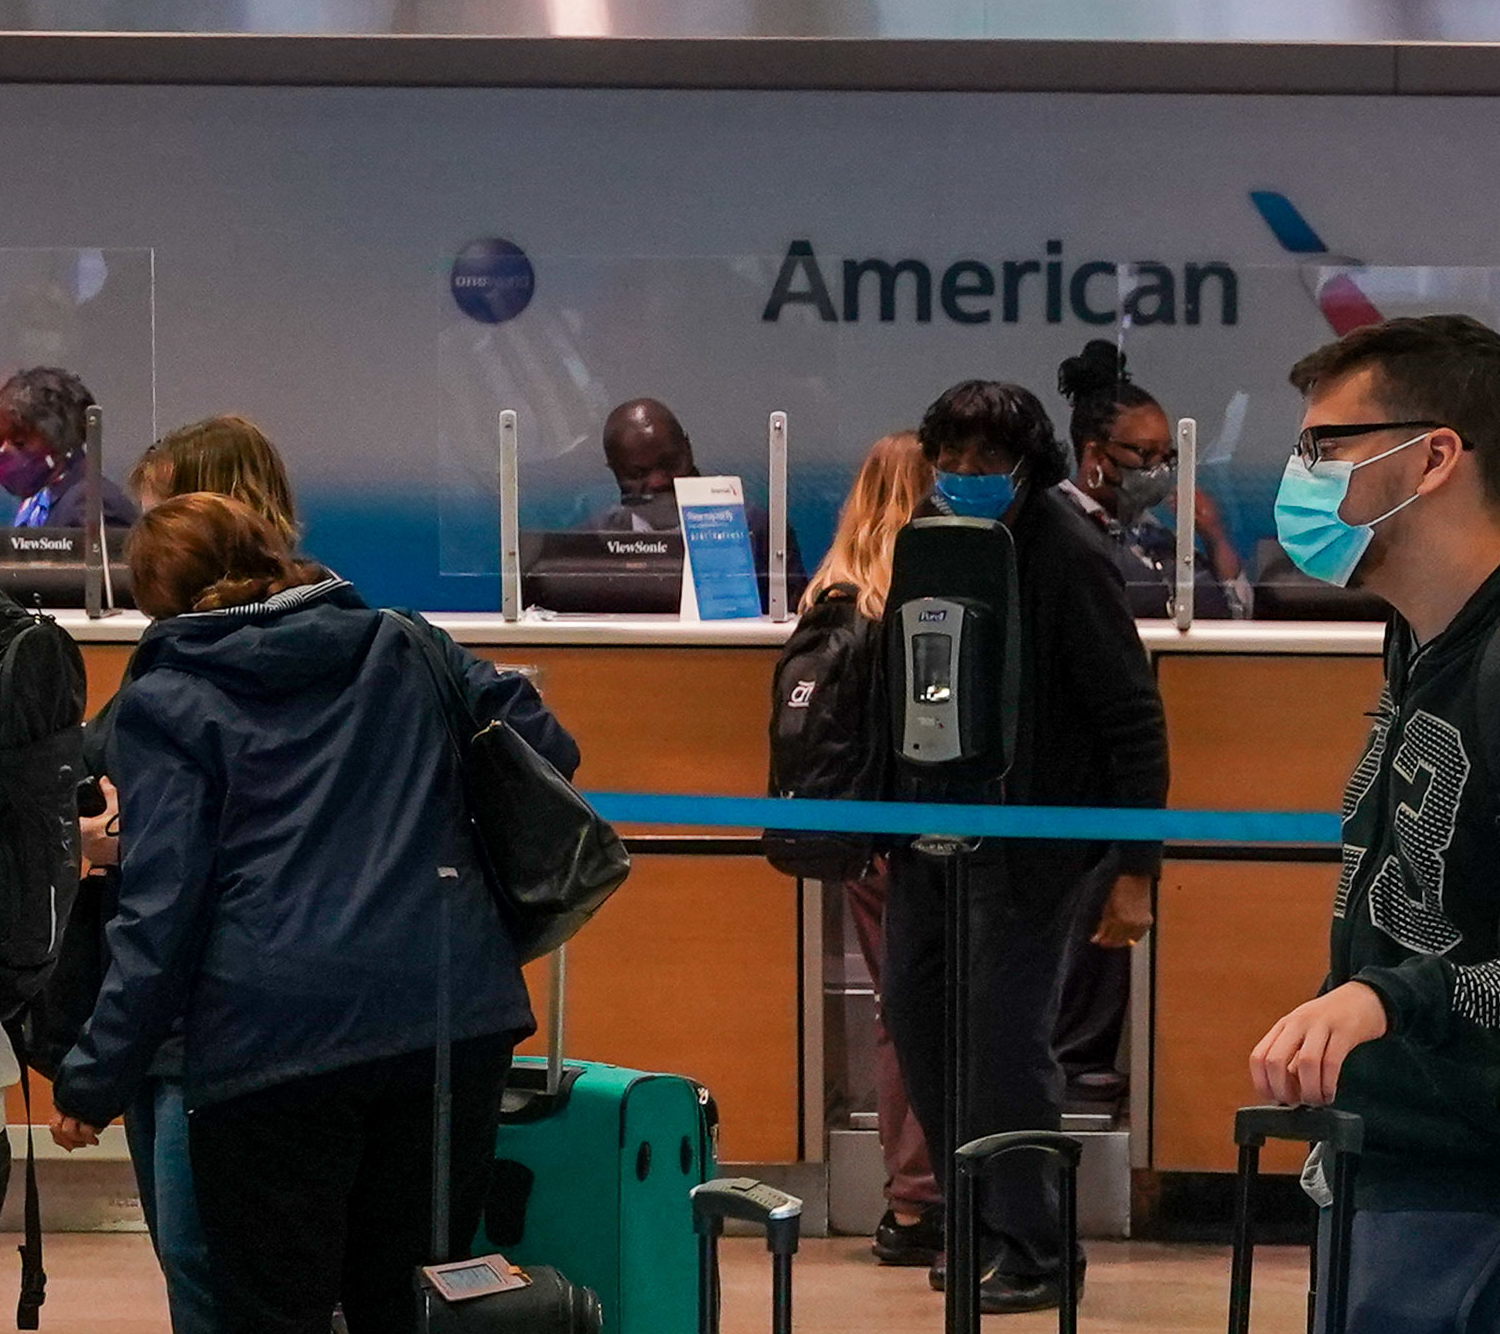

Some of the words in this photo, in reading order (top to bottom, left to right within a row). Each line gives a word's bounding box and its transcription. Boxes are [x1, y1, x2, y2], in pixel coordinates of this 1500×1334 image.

[761, 239, 1238, 327] American
[10, 537, 73, 550] ViewSonic
[606, 540, 668, 553] ViewSonic
